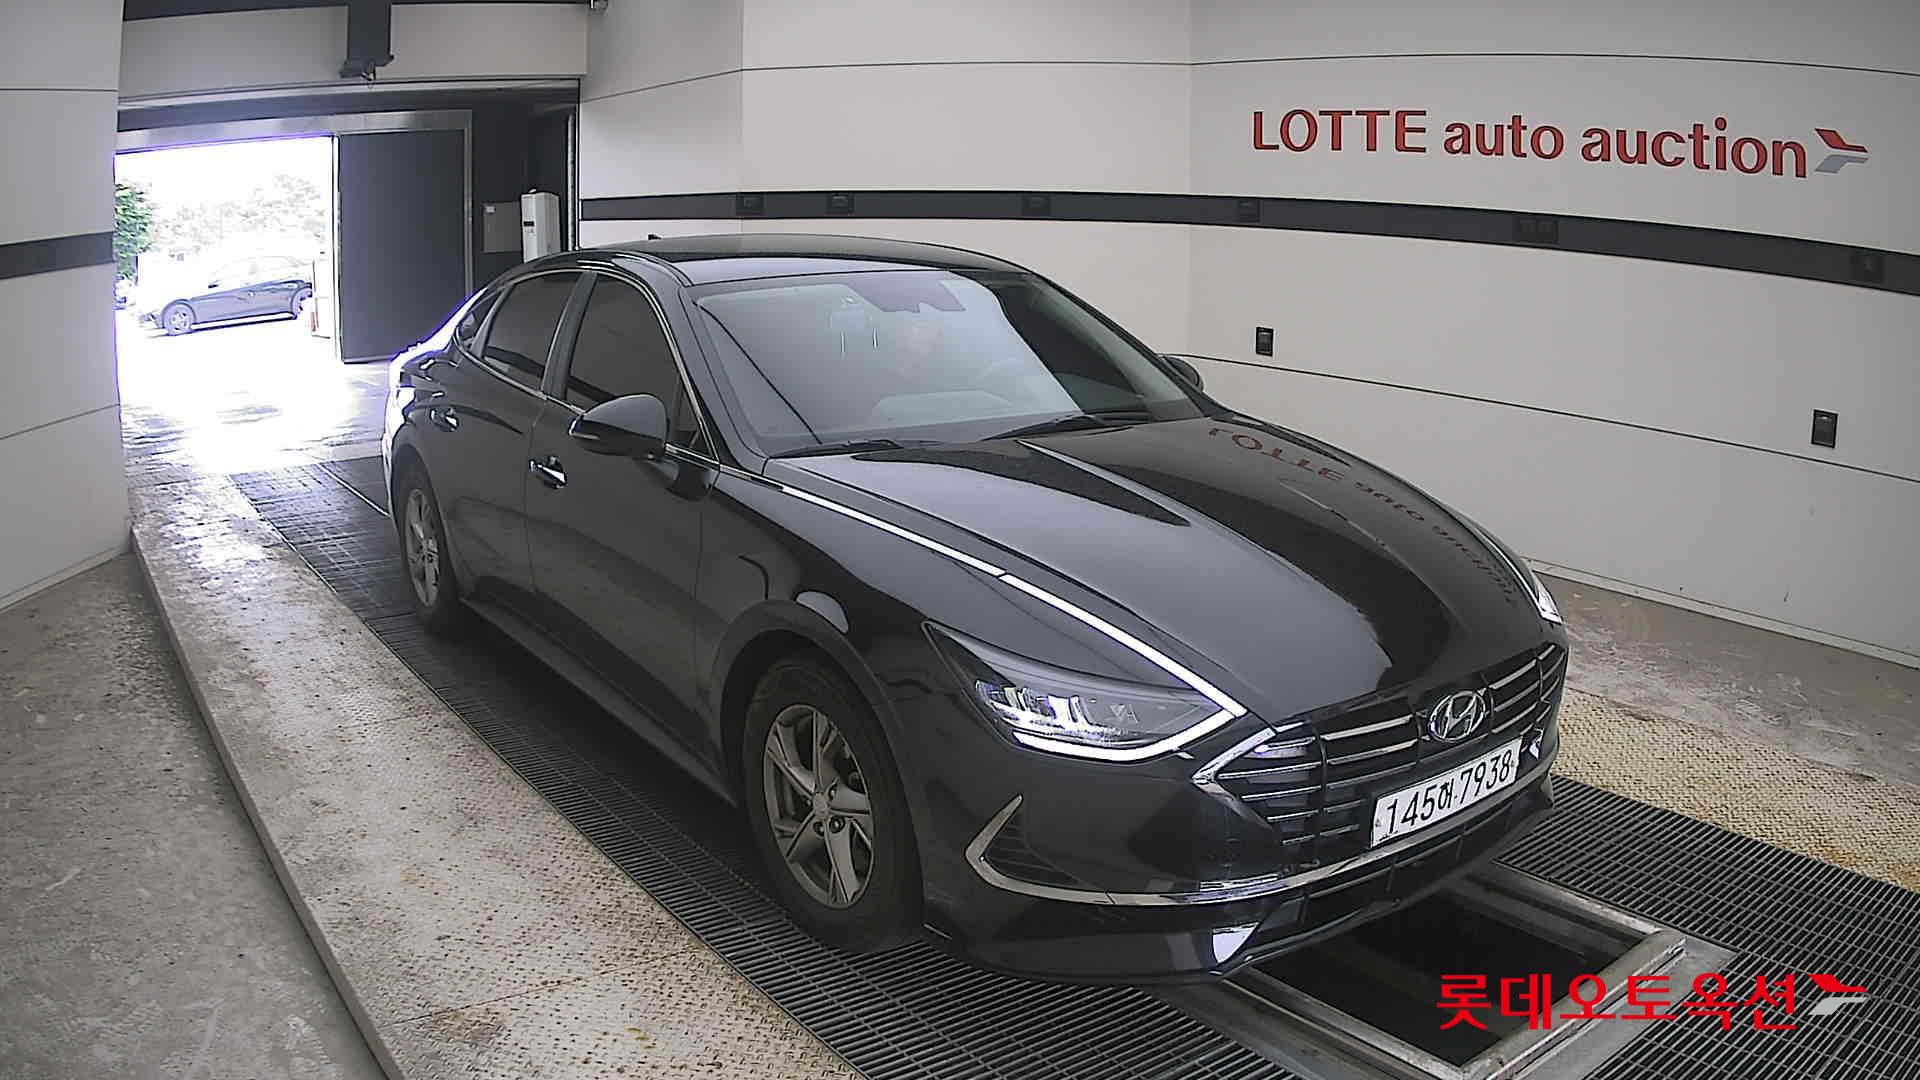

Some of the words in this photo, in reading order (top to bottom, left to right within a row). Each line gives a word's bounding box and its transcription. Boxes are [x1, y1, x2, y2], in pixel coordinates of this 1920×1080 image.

[1253, 109, 1427, 153] LOTTE
[1443, 114, 1565, 159] auto
[1580, 117, 1808, 178] auction
